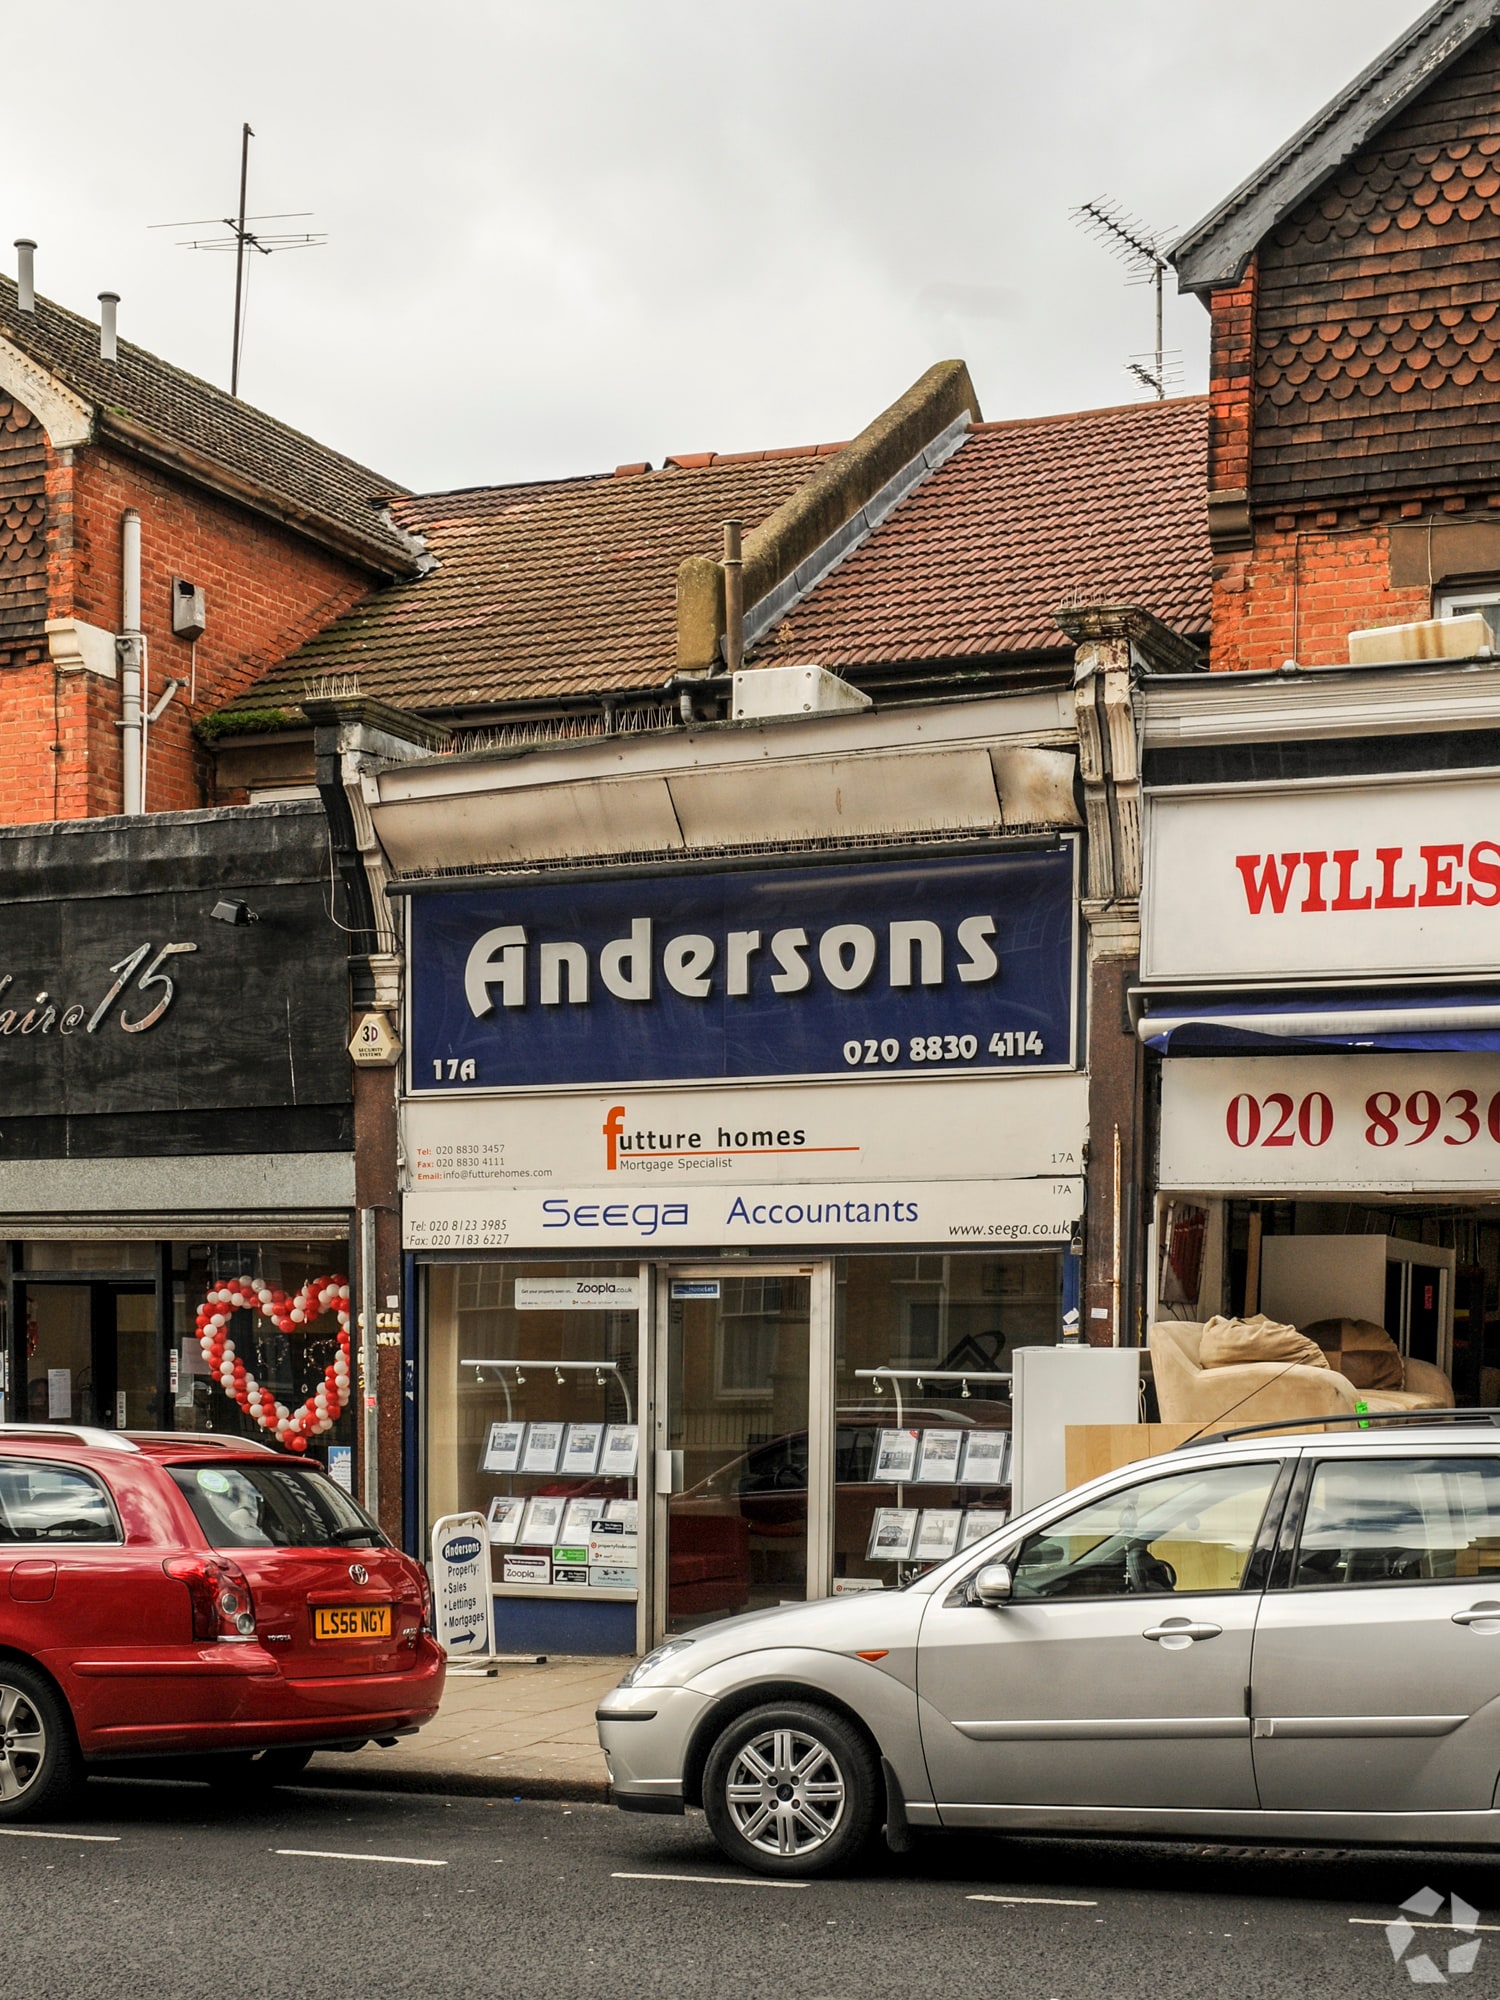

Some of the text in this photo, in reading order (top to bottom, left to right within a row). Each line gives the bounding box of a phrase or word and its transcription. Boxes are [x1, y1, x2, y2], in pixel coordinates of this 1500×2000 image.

[465, 915, 997, 1018] Andersons
[362, 1026, 378, 1042] 3D
[843, 1031, 1044, 1065] 020 8830 4114
[433, 1058, 476, 1081] 17A
[1226, 1092, 1334, 1148] 020
[602, 1106, 806, 1170] futture homes
[436, 1146, 453, 1155] 020
[456, 1145, 479, 1154] 8830
[482, 1144, 505, 1153] 3457
[436, 1158, 453, 1168] 020
[456, 1158, 479, 1167] 8830
[482, 1157, 505, 1166] 4111
[620, 1157, 732, 1172] Mortgage Specialist
[1051, 1152, 1074, 1164] 17A
[443, 1168, 553, 1180] info@futturehomes.com
[1052, 1185, 1072, 1194] 17A
[542, 1196, 918, 1235] Seega Accountants
[410, 1219, 507, 1231] Tel: 020 8123 3985
[949, 1220, 1070, 1239] www.seega.co.uk
[409, 1234, 509, 1246] Fax: 020 7183 6227
[445, 1542, 480, 1558] Andersons
[448, 1563, 479, 1577] Property:
[448, 1582, 467, 1594] Sales
[449, 1597, 476, 1611] Lettings
[321, 1611, 385, 1635] LS56 NGY
[449, 1612, 484, 1628] Mortgages
[267, 1634, 291, 1642] TOYOTA
